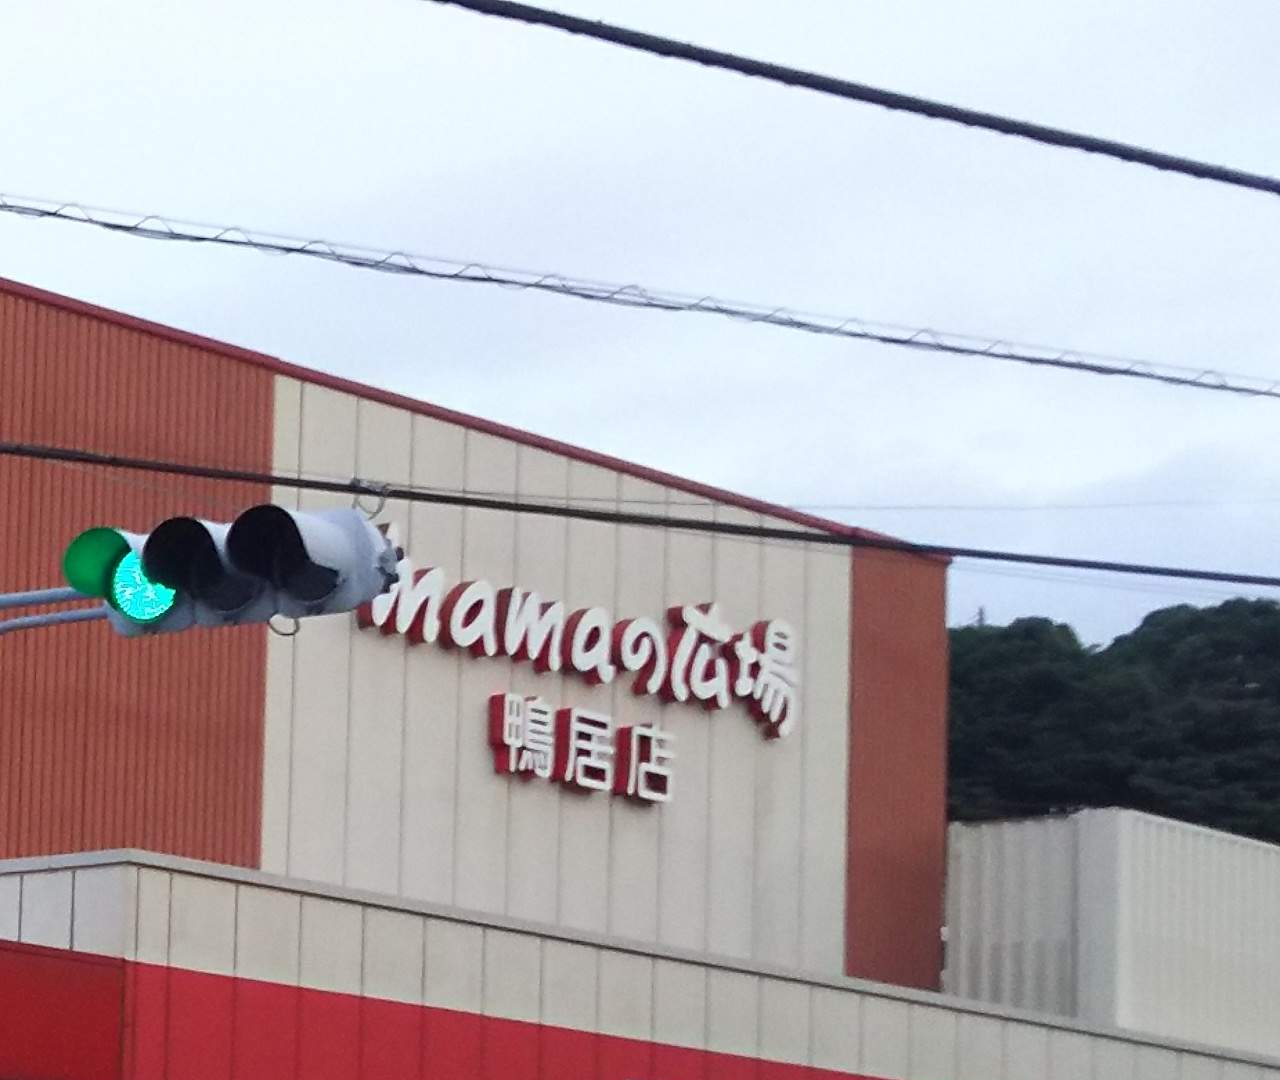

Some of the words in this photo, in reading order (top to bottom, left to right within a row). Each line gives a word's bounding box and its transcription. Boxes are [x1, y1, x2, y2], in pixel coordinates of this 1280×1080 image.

[372, 523, 801, 738] mamaの広場
[503, 693, 675, 802] 鴨居店
